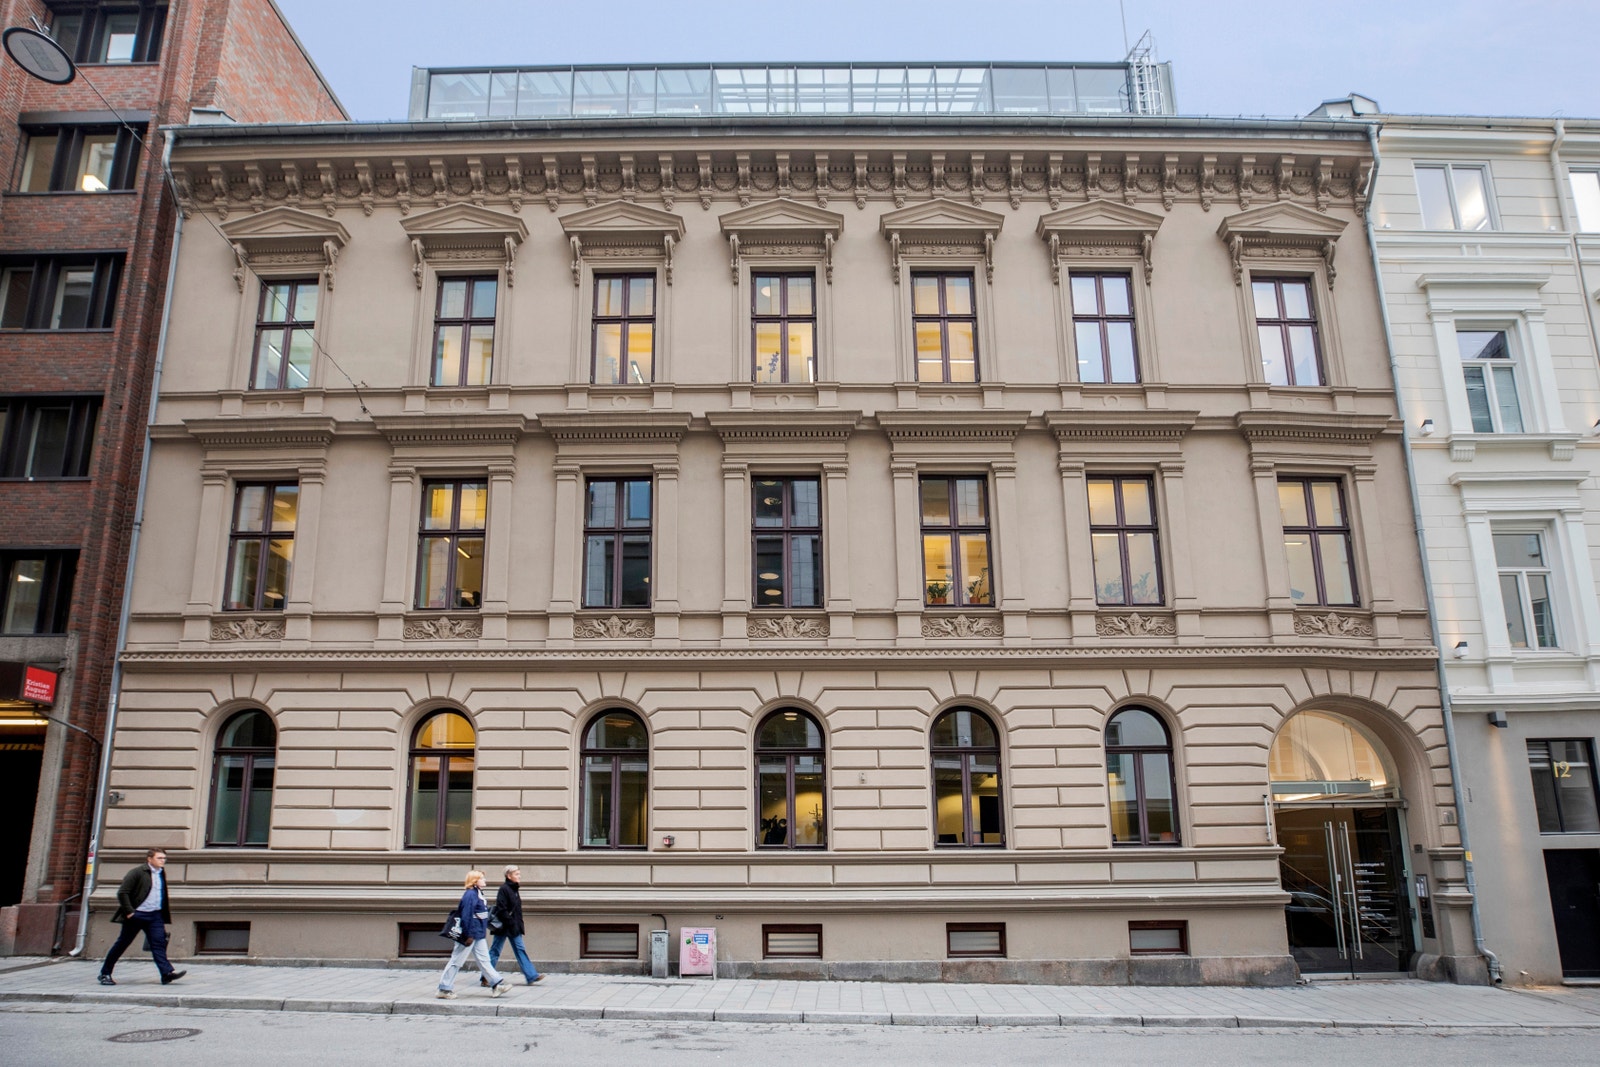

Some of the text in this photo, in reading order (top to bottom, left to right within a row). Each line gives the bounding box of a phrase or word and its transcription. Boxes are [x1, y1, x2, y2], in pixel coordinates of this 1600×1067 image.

[26, 679, 50, 689] Kristian
[25, 685, 49, 694] August-
[24, 691, 51, 701] kvartalet
[1553, 761, 1572, 778] 12
[1323, 782, 1338, 795] 10
